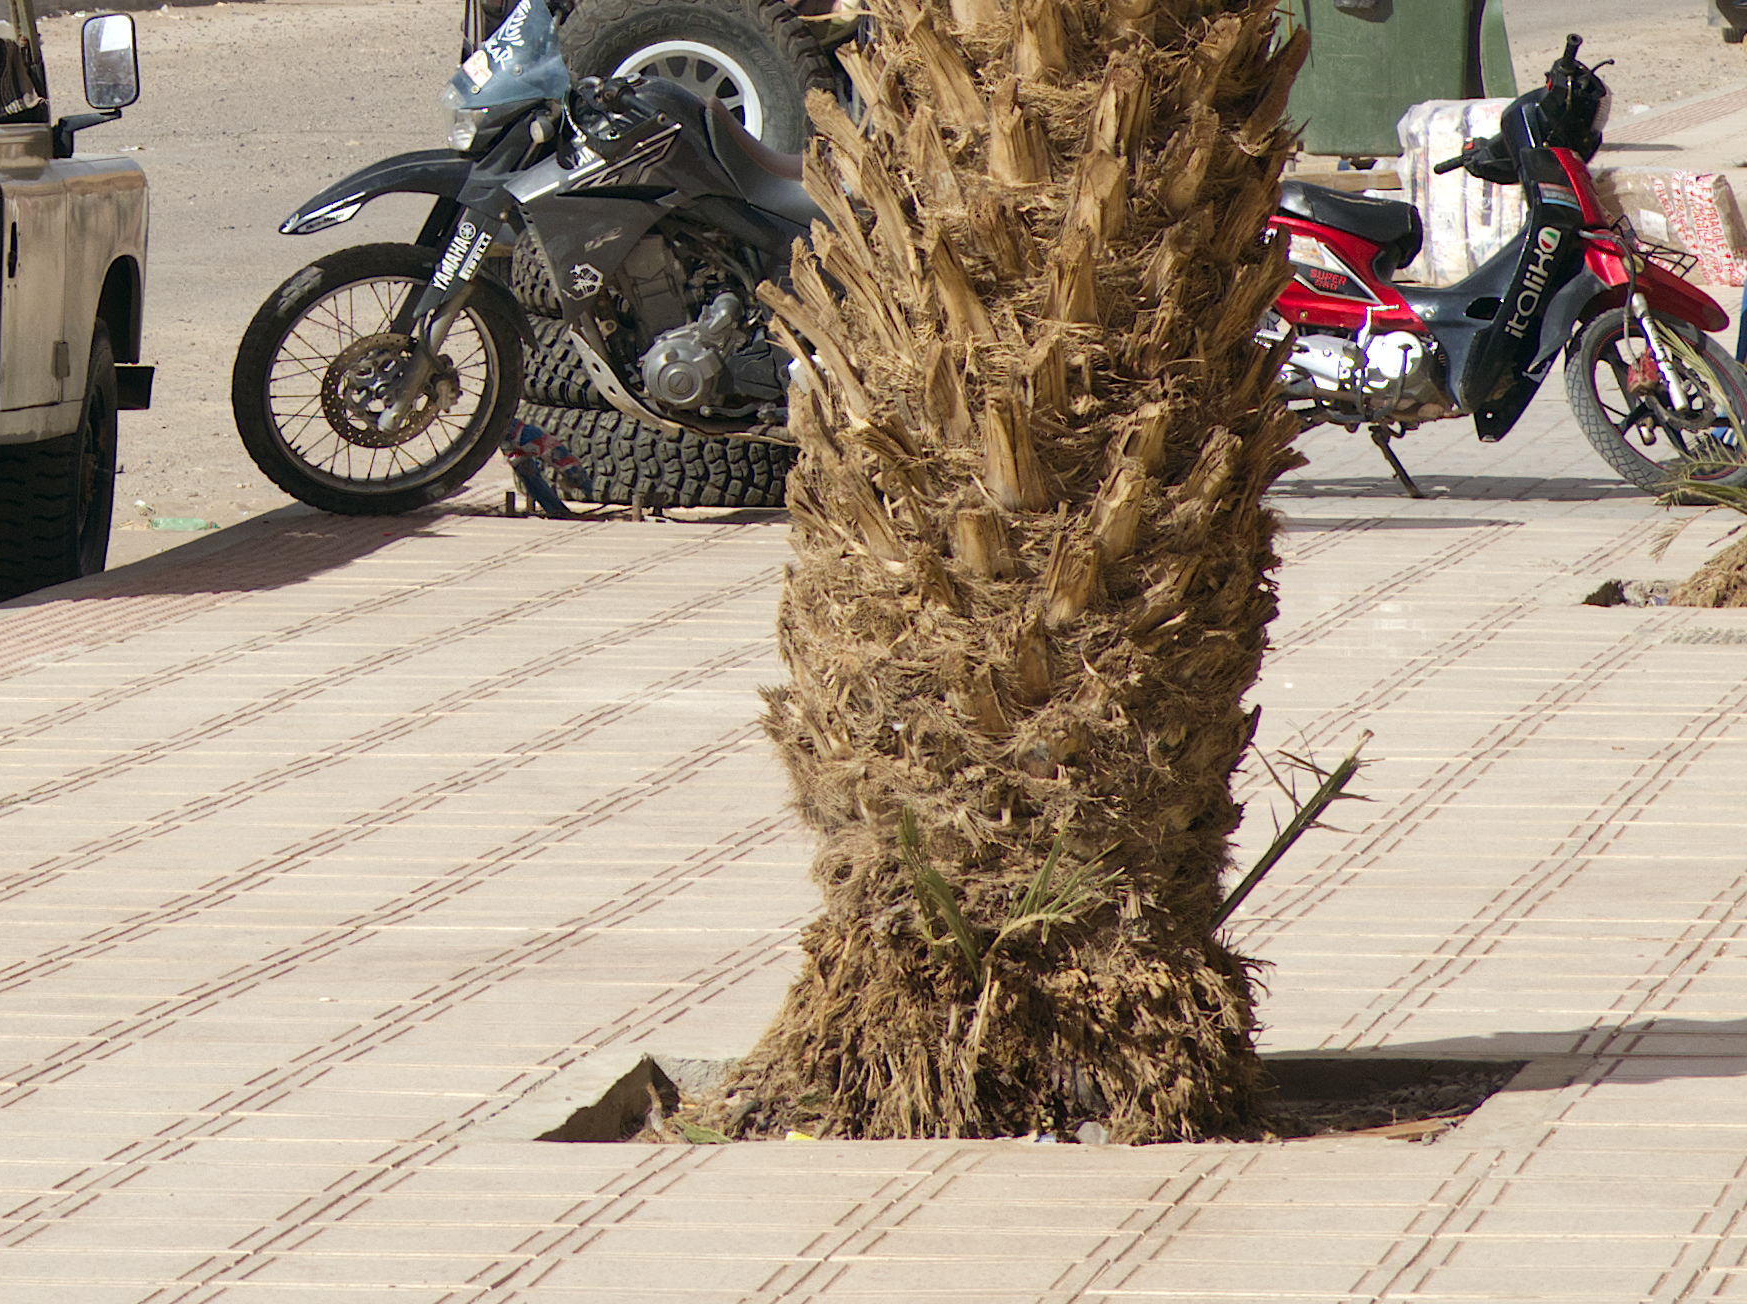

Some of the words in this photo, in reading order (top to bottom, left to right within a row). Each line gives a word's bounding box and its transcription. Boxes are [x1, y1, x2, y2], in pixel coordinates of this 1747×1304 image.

[1705, 206, 1729, 251] FRAGILE
[432, 235, 472, 292] YAMAHA
[1504, 226, 1562, 340] italika
